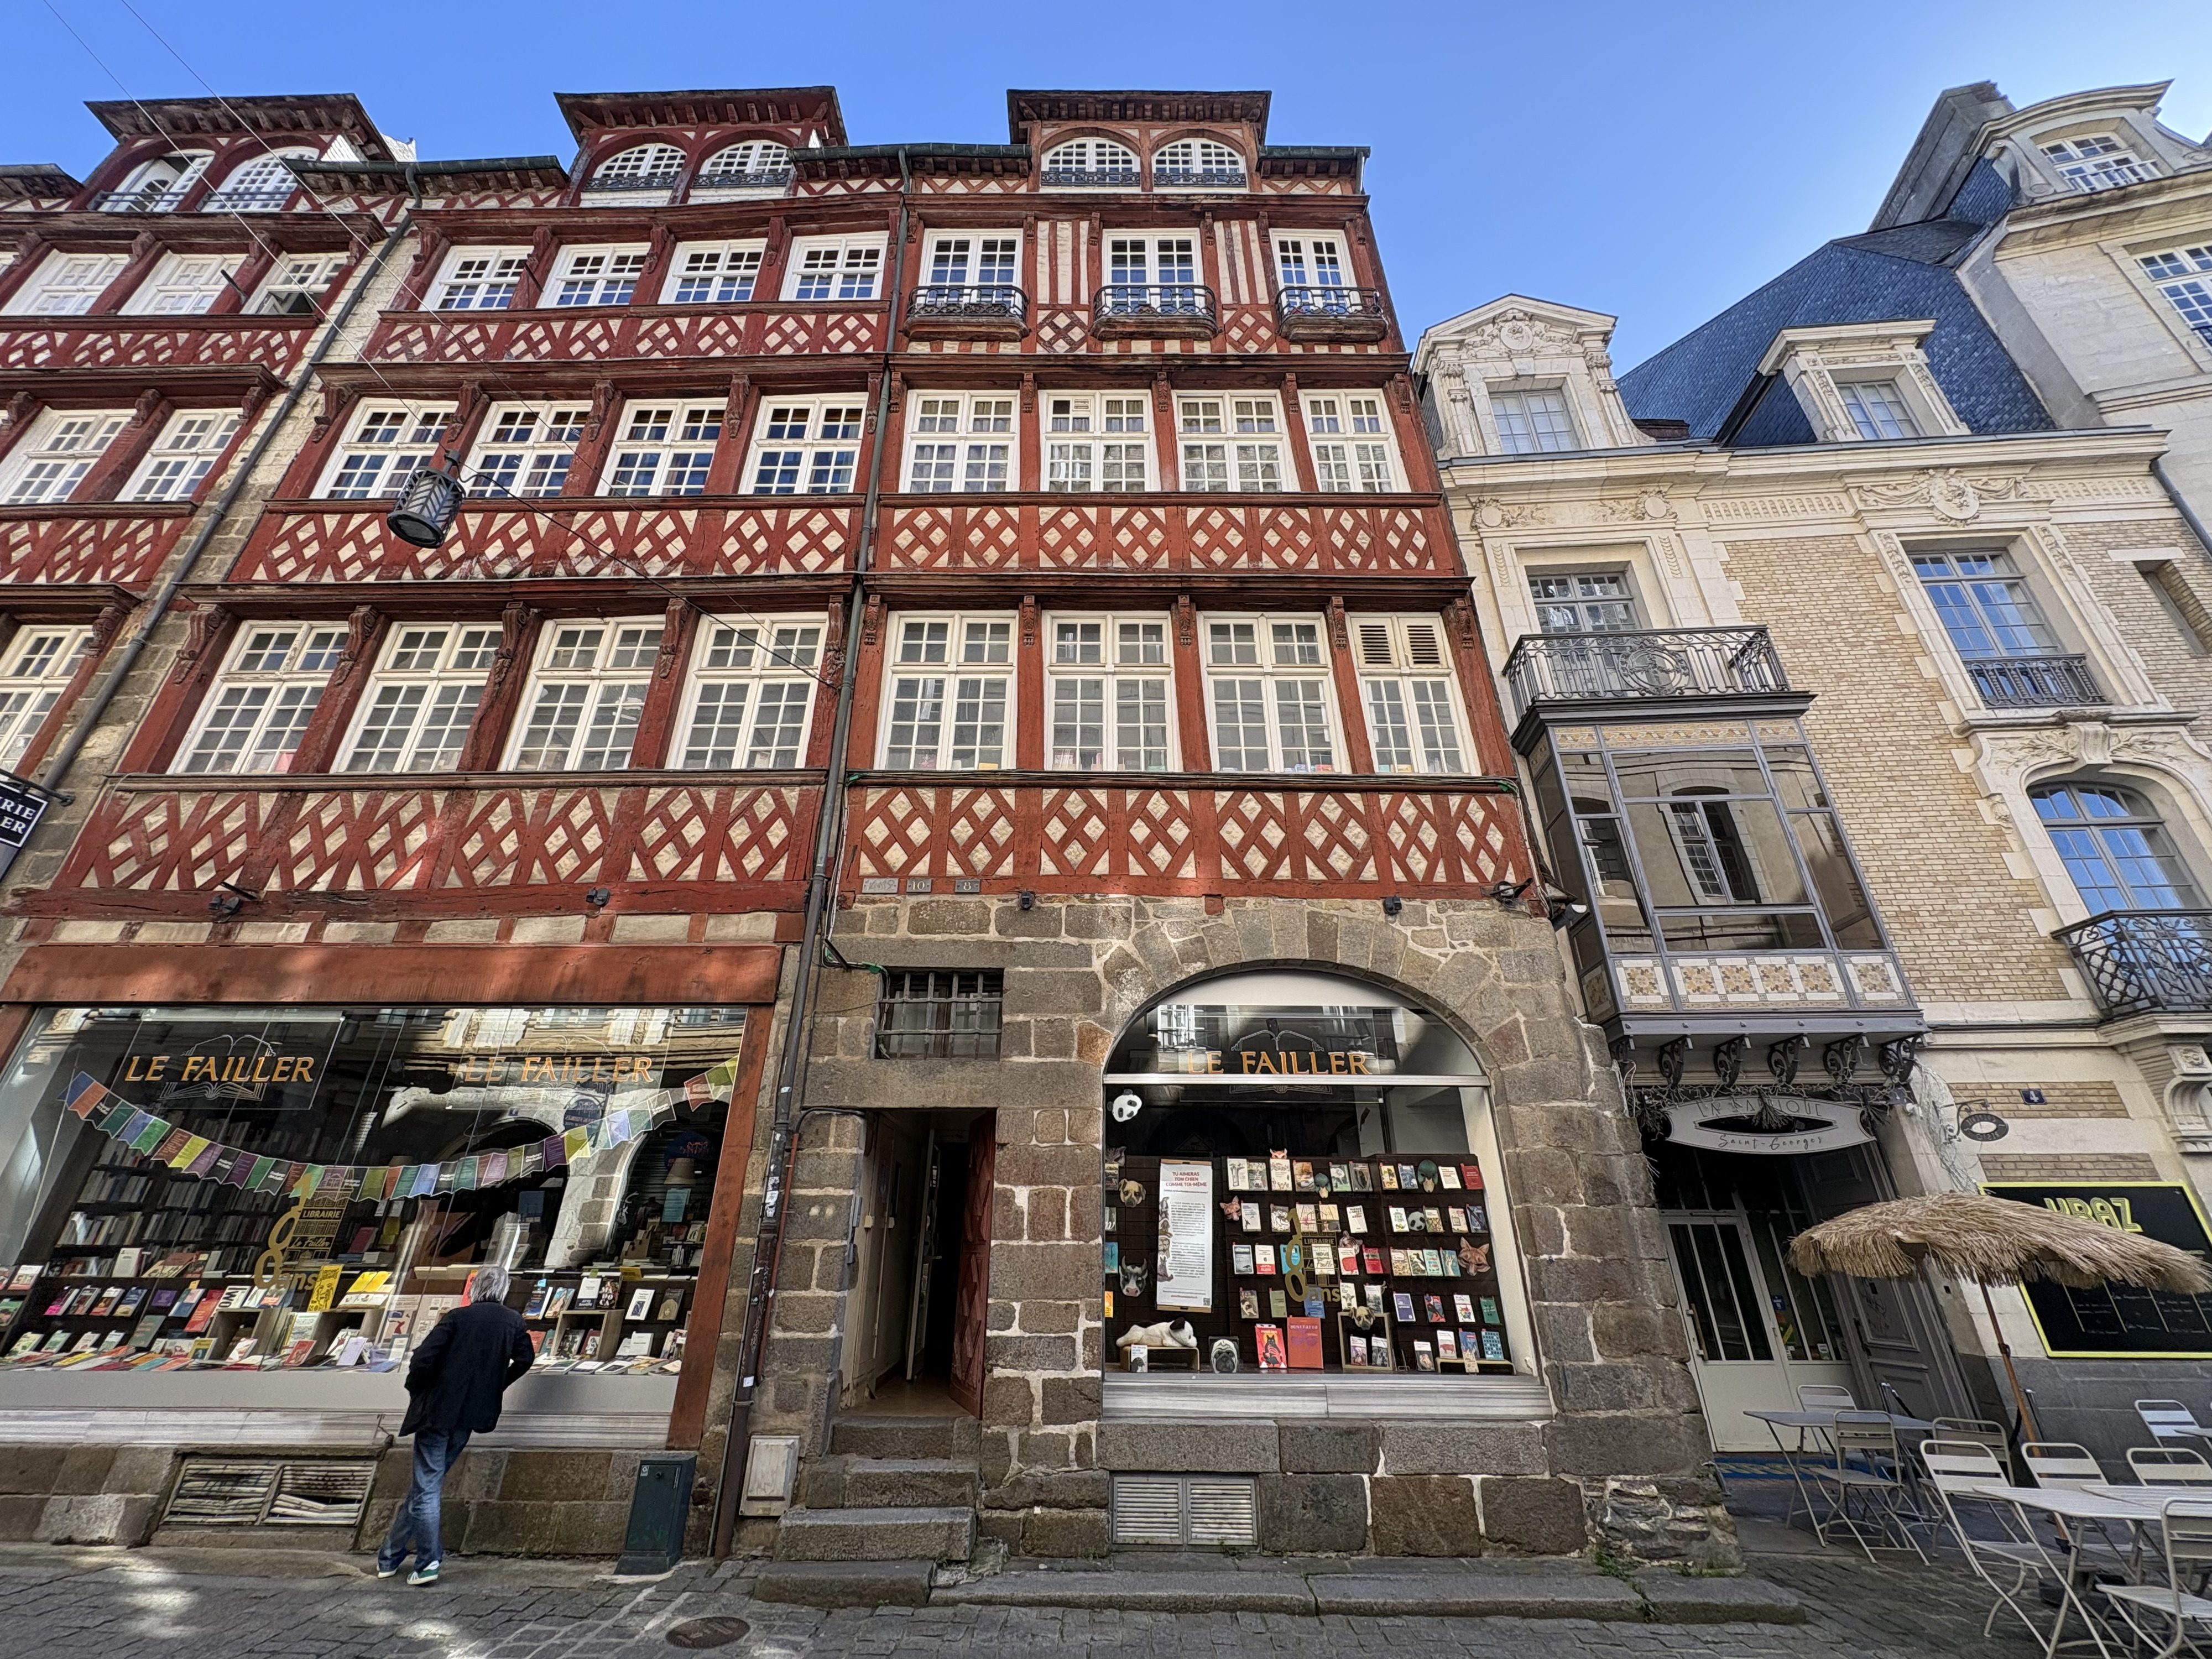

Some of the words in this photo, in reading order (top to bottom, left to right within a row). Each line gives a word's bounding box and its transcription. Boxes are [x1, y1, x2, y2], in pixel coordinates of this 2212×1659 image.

[0, 796, 36, 820] RIE
[912, 880, 925, 890] 10
[963, 881, 972, 890] 8
[124, 1056, 170, 1082] LE
[181, 1056, 315, 1082] FAILLER
[465, 1056, 506, 1082] LE
[520, 1056, 654, 1082] FAILLER
[1187, 1051, 1224, 1074] LE
[1240, 1051, 1373, 1074] FAILLER
[2029, 1091, 2039, 1103] 4
[1718, 1134, 1823, 1151] Saint-Georges
[302, 1210, 342, 1218] LIBRAIRIE
[278, 1272, 320, 1291] ans
[1308, 1287, 1340, 1302] ans
